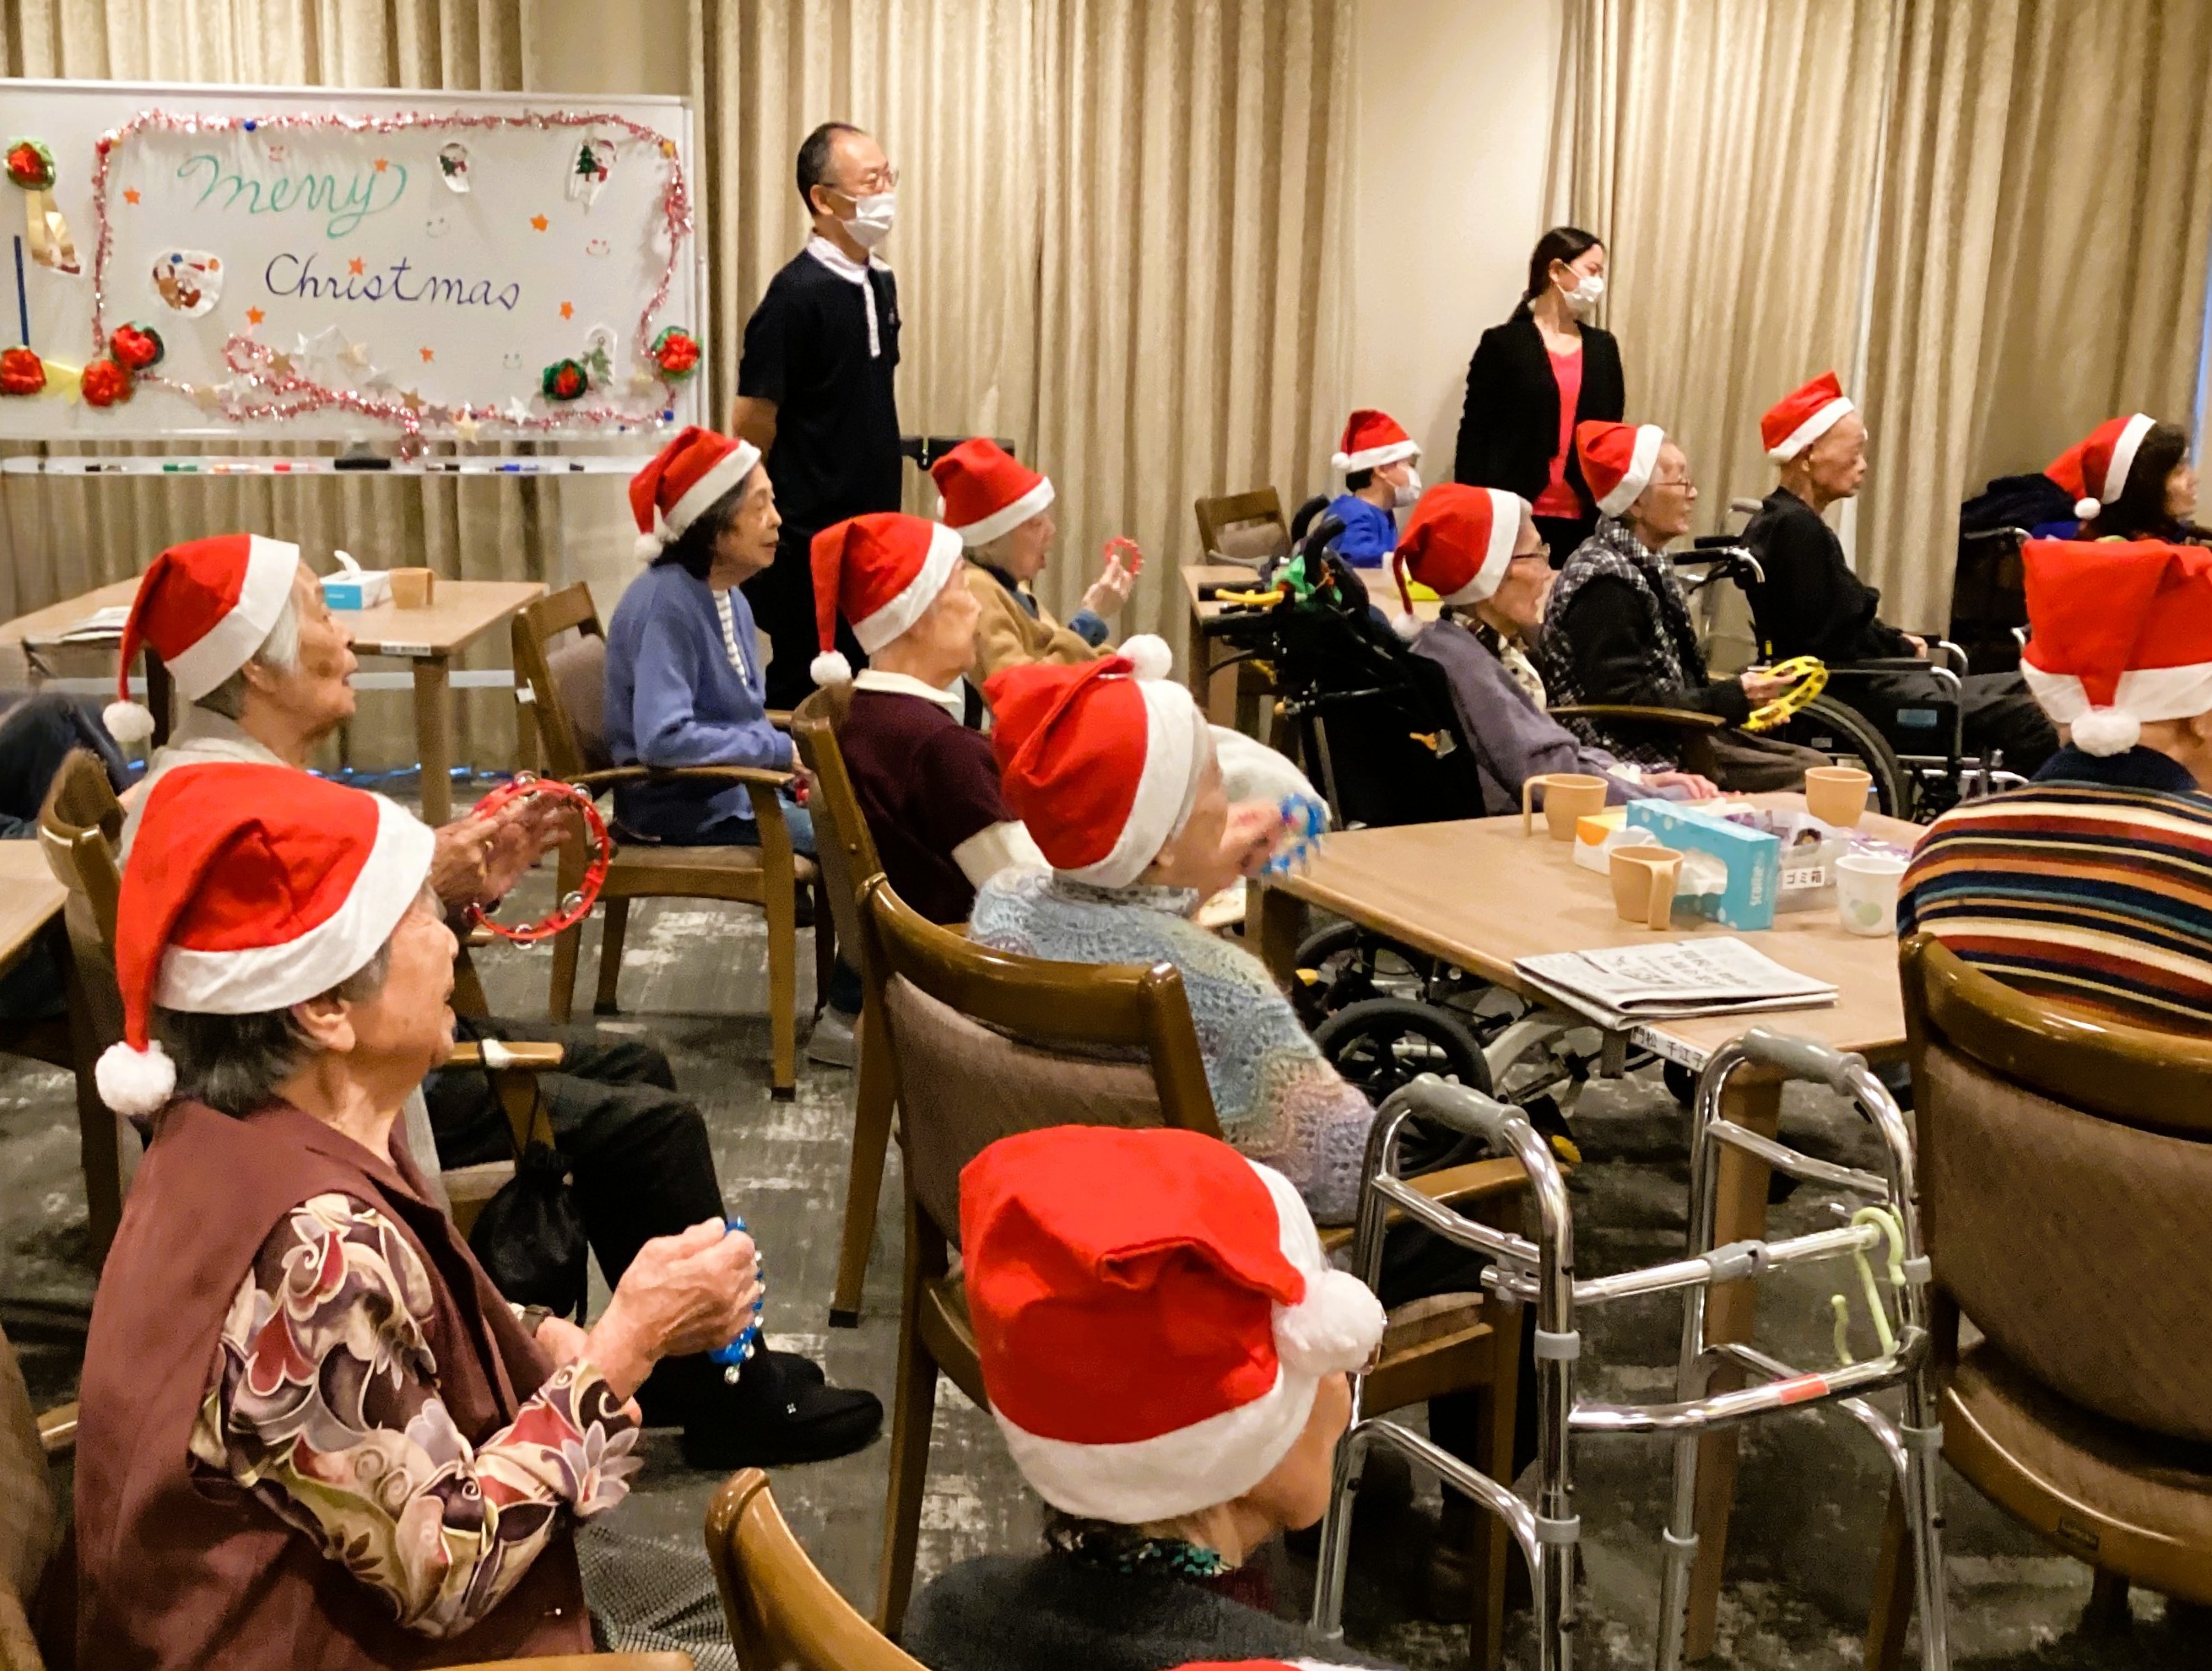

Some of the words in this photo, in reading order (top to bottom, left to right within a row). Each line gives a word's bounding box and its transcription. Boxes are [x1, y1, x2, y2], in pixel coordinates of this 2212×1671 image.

[266, 252, 520, 311] Christmas
[1786, 869, 1822, 886] ゴミ箱
